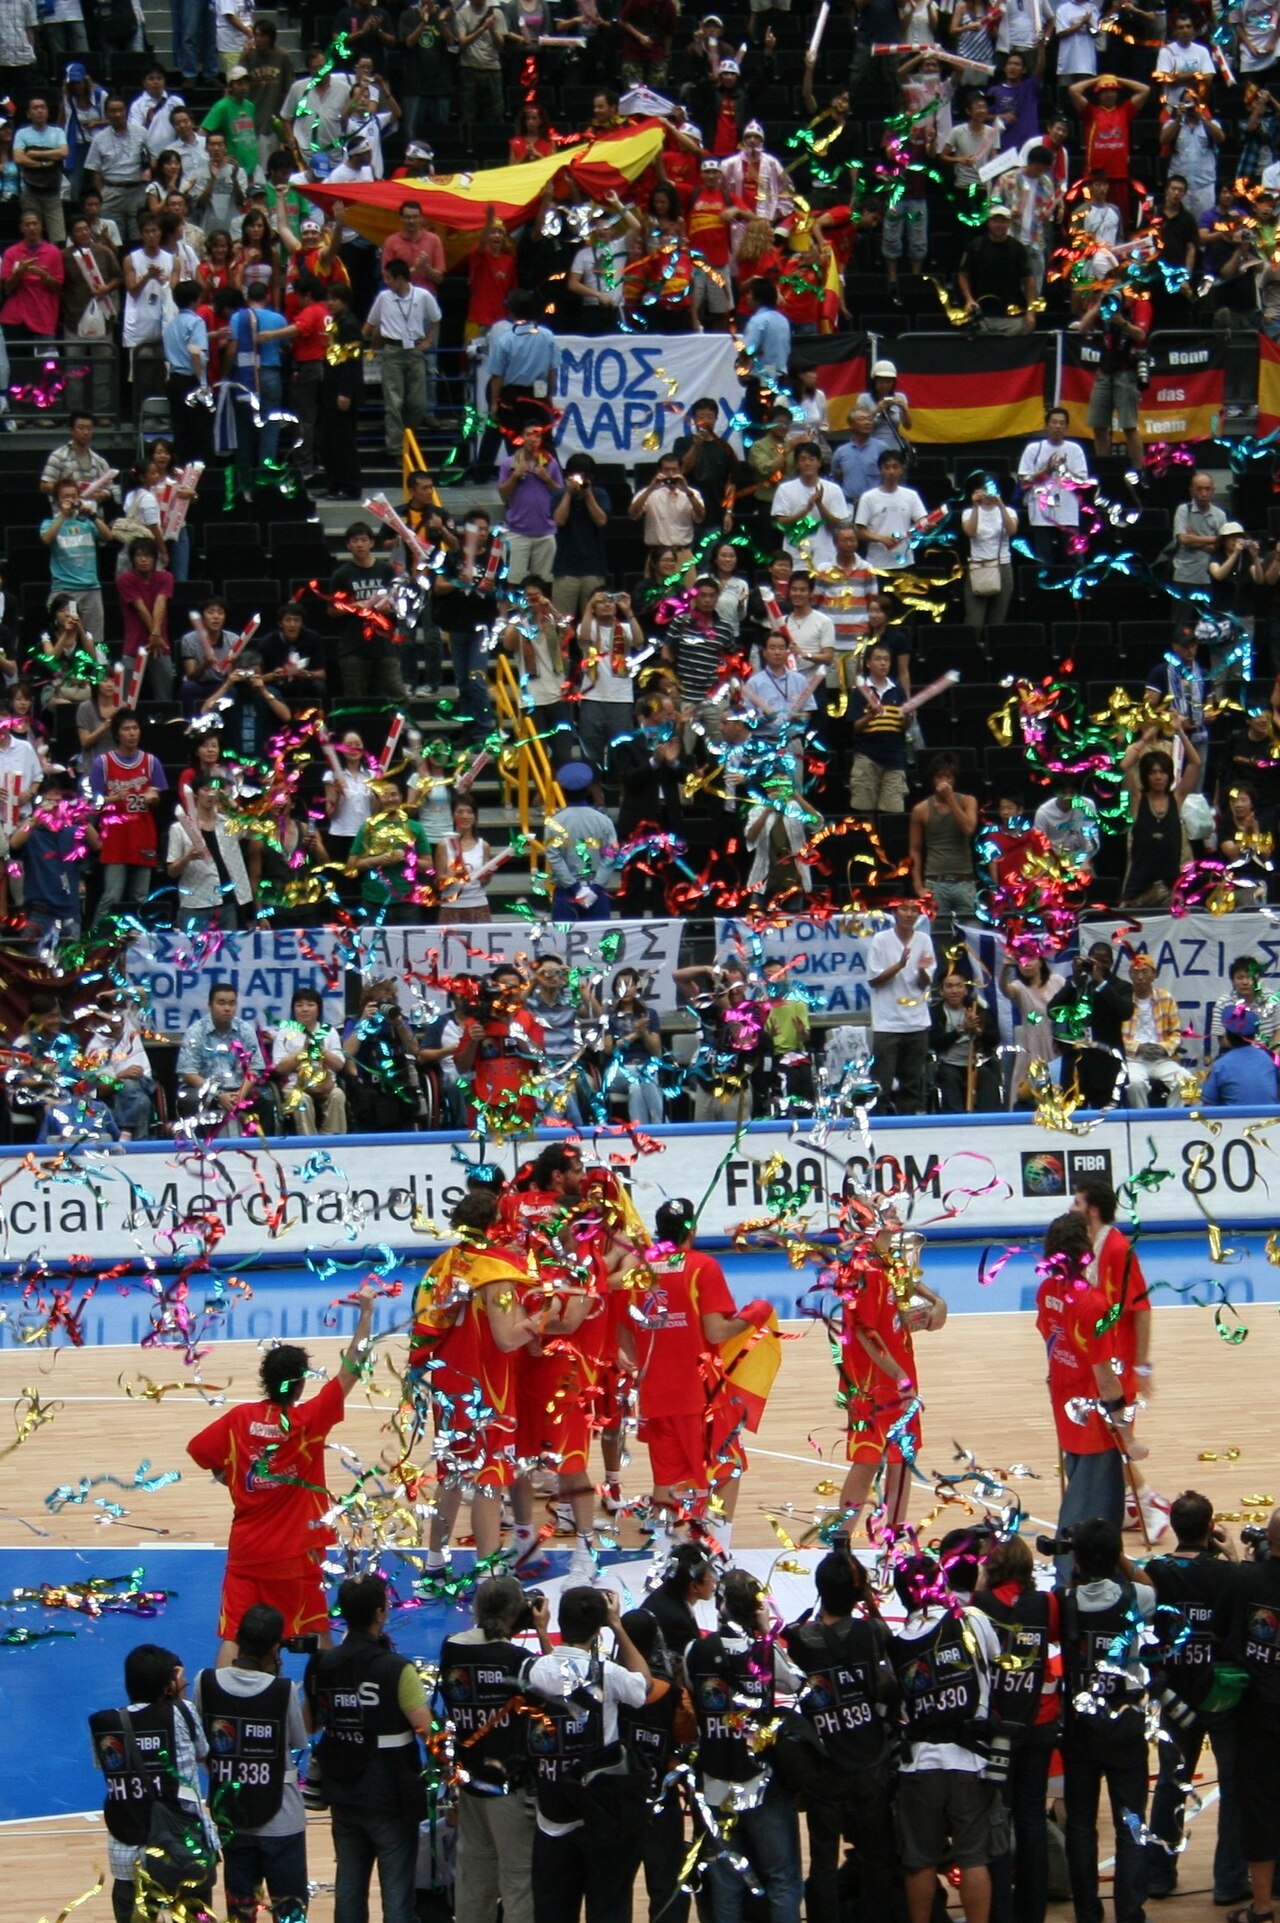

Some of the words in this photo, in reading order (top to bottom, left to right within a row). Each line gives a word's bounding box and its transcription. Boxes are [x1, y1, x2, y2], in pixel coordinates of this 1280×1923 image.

[1168, 349, 1208, 366] Bonn
[1156, 388, 1185, 403] das
[1144, 419, 1187, 435] Team
[127, 794, 148, 813] 23
[1074, 1155, 1105, 1173] FIBA
[1181, 1138, 1257, 1194] 80
[0, 1186, 103, 1235] cial
[130, 1174, 465, 1230] Merchandis
[1016, 1632, 1042, 1646] FIBA
[1095, 1636, 1114, 1649] FIB
[936, 1647, 961, 1667] FIBA
[1186, 1644, 1212, 1665] 551
[1246, 1641, 1270, 1664] PH
[477, 1670, 504, 1684] FIBA
[1004, 1670, 1035, 1693] 574
[334, 1694, 358, 1708] FIBA
[453, 1708, 473, 1730] PH
[566, 1720, 585, 1735] FIB
[814, 1712, 841, 1736] PH
[843, 1702, 873, 1730] 339
[245, 1723, 273, 1739] FIBA
[635, 1728, 661, 1747] FIBA
[211, 1758, 233, 1782] PH
[238, 1762, 271, 1785] 338
[108, 1777, 127, 1800] PH
[131, 1776, 163, 1798] 31
